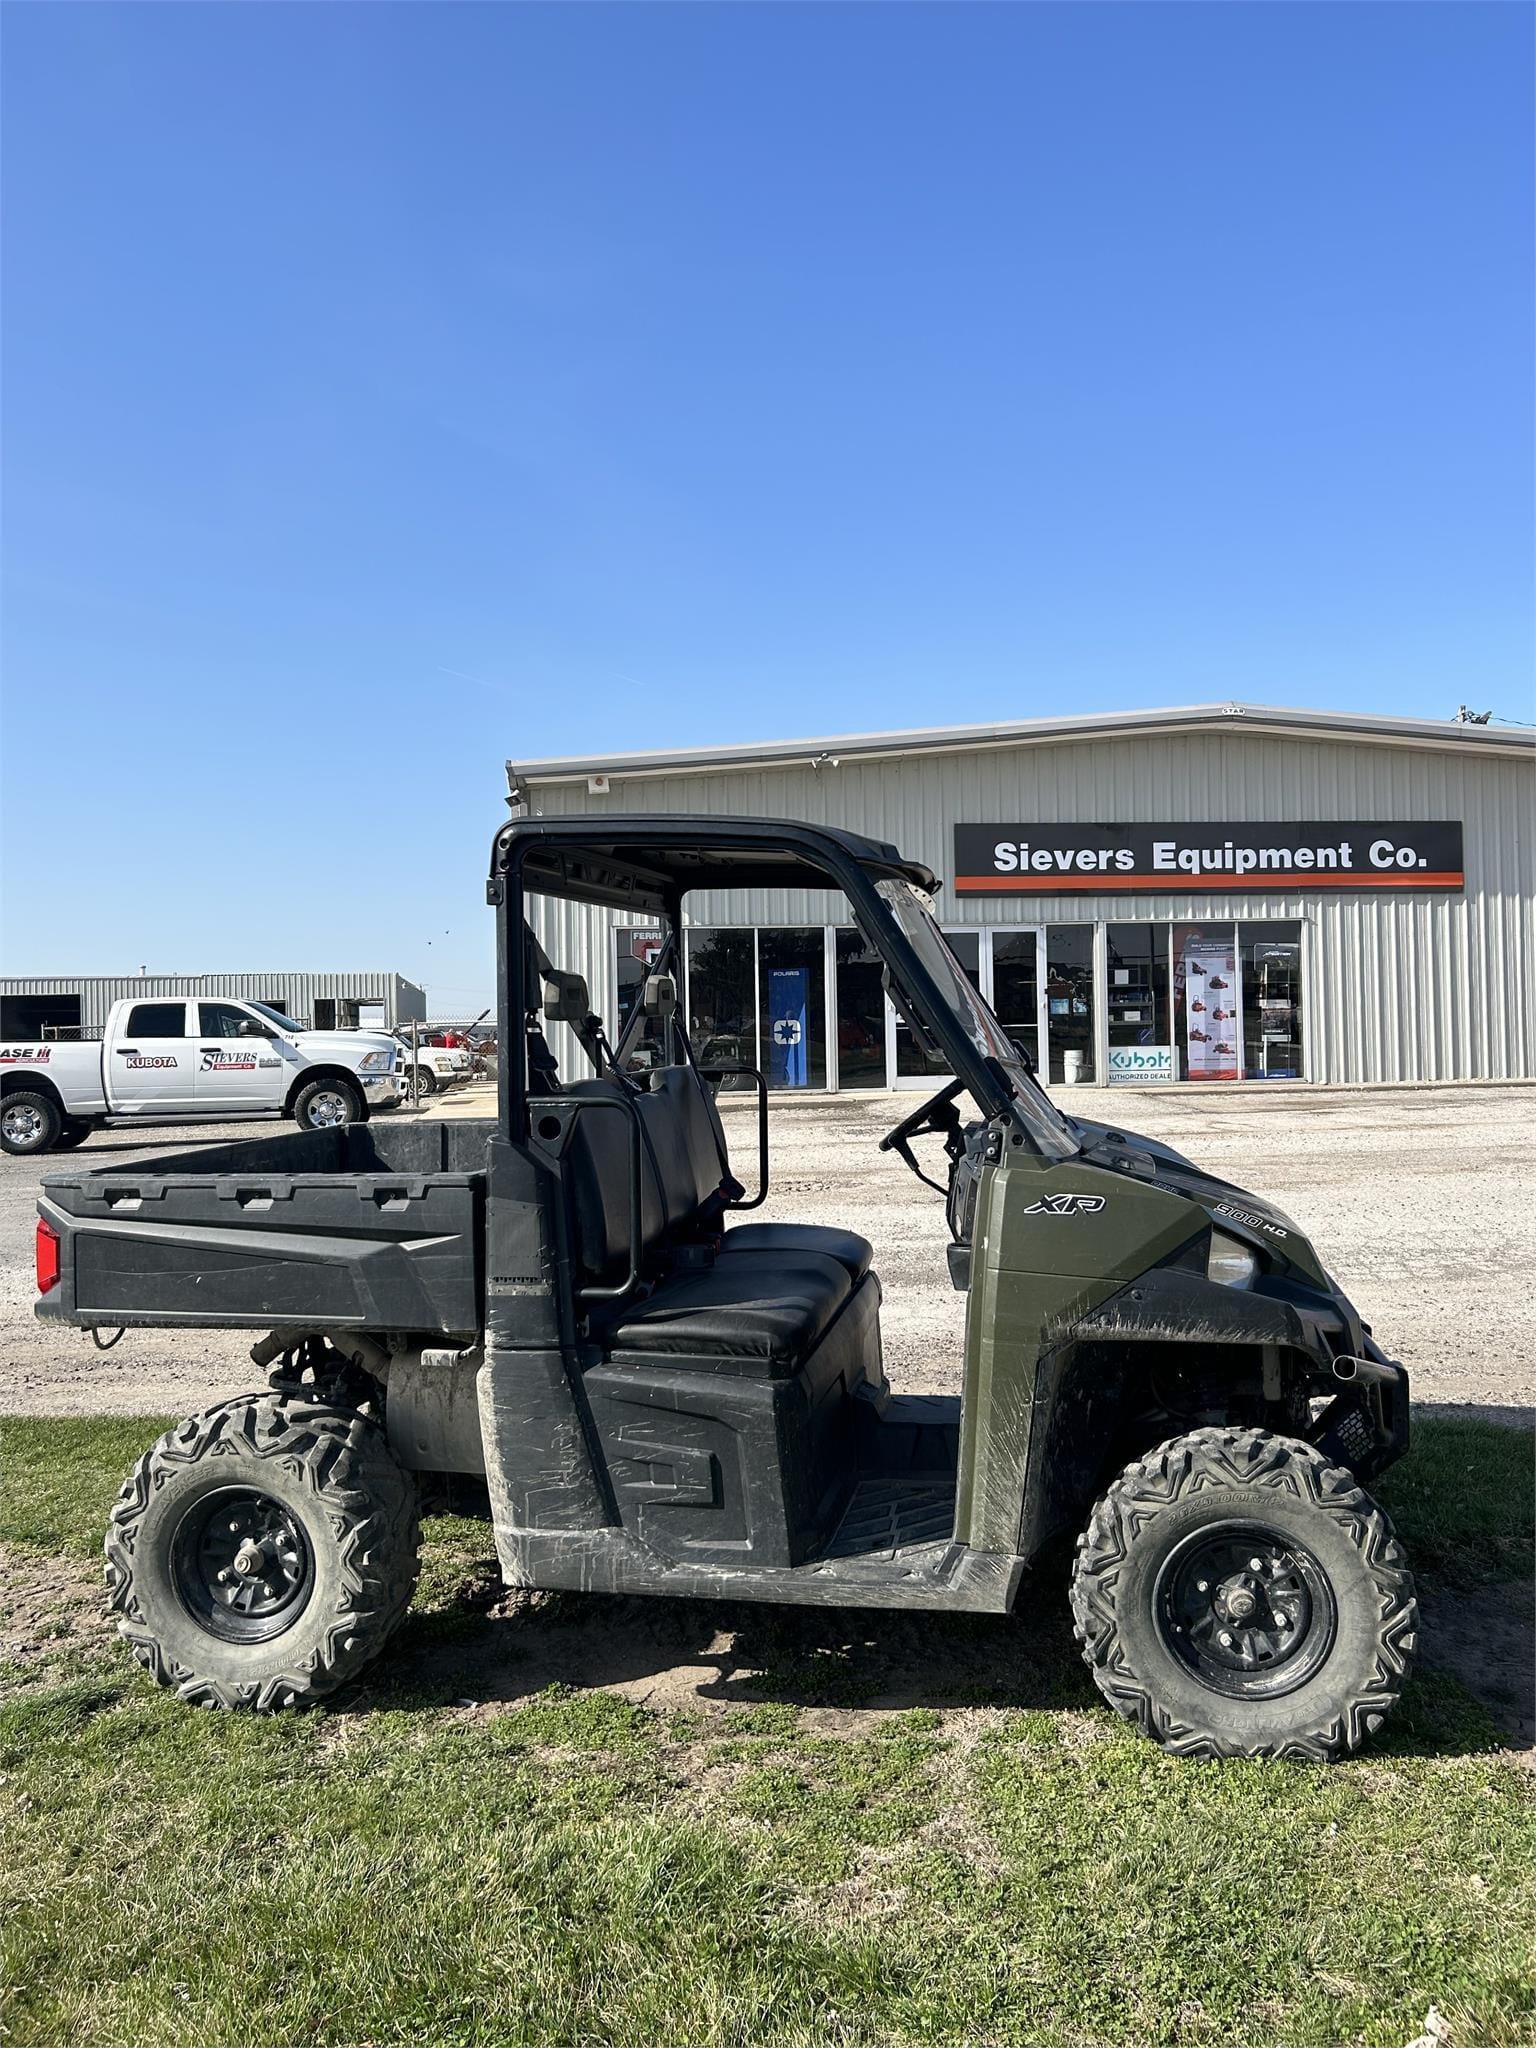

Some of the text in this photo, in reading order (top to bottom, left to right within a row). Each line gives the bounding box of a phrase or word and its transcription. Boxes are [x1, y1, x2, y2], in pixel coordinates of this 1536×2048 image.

[993, 840, 1428, 874] Sievers Equipment Co.
[633, 932, 662, 940] FERRI
[0, 1048, 34, 1058] ASE
[127, 1056, 178, 1068] KUBOTA
[200, 1052, 258, 1072] SIEVERS
[1150, 1072, 1171, 1080] DEALE
[1024, 1193, 1107, 1216] XP
[1213, 1203, 1264, 1228] 900
